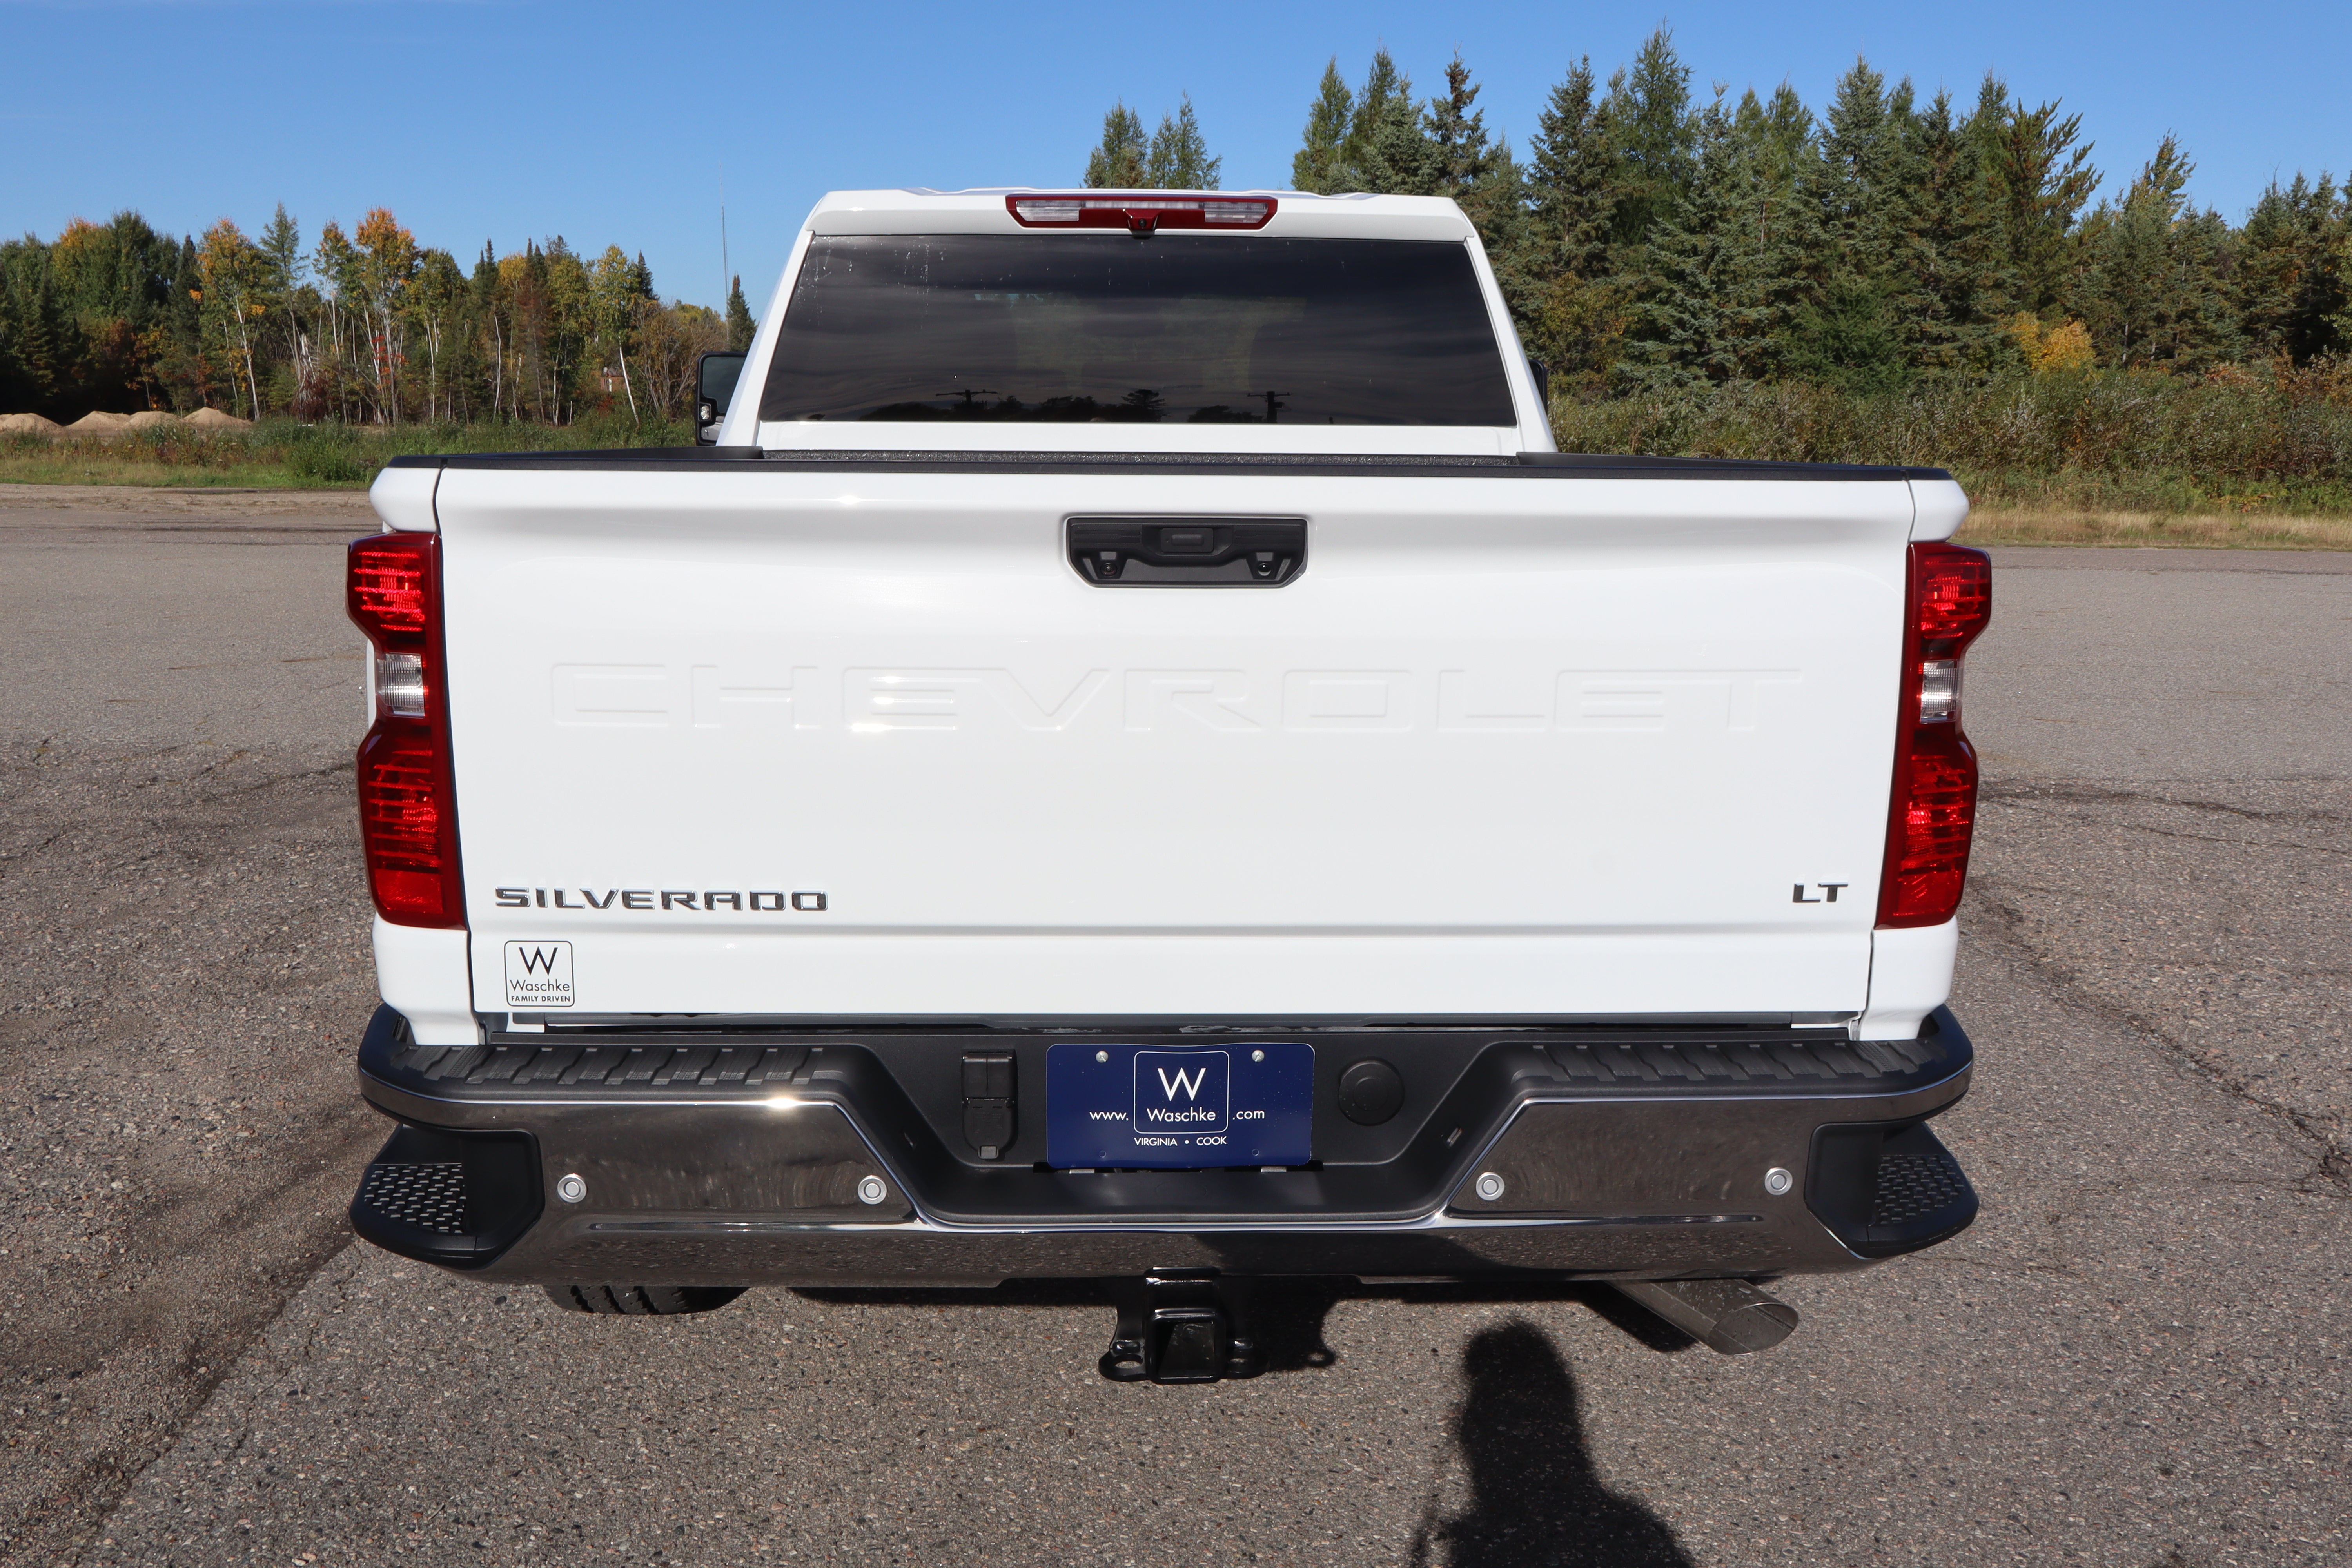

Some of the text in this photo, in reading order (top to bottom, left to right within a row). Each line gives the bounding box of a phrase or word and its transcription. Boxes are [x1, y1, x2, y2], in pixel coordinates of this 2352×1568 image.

[551, 662, 1802, 732] CHEVROLET
[494, 886, 829, 911] SILVERADO
[1792, 882, 1849, 903] LT
[509, 978, 570, 993] Waschke
[1089, 1106, 1265, 1122] www. Waschke .com
[1134, 1136, 1227, 1146] VIRGINIA COOK
